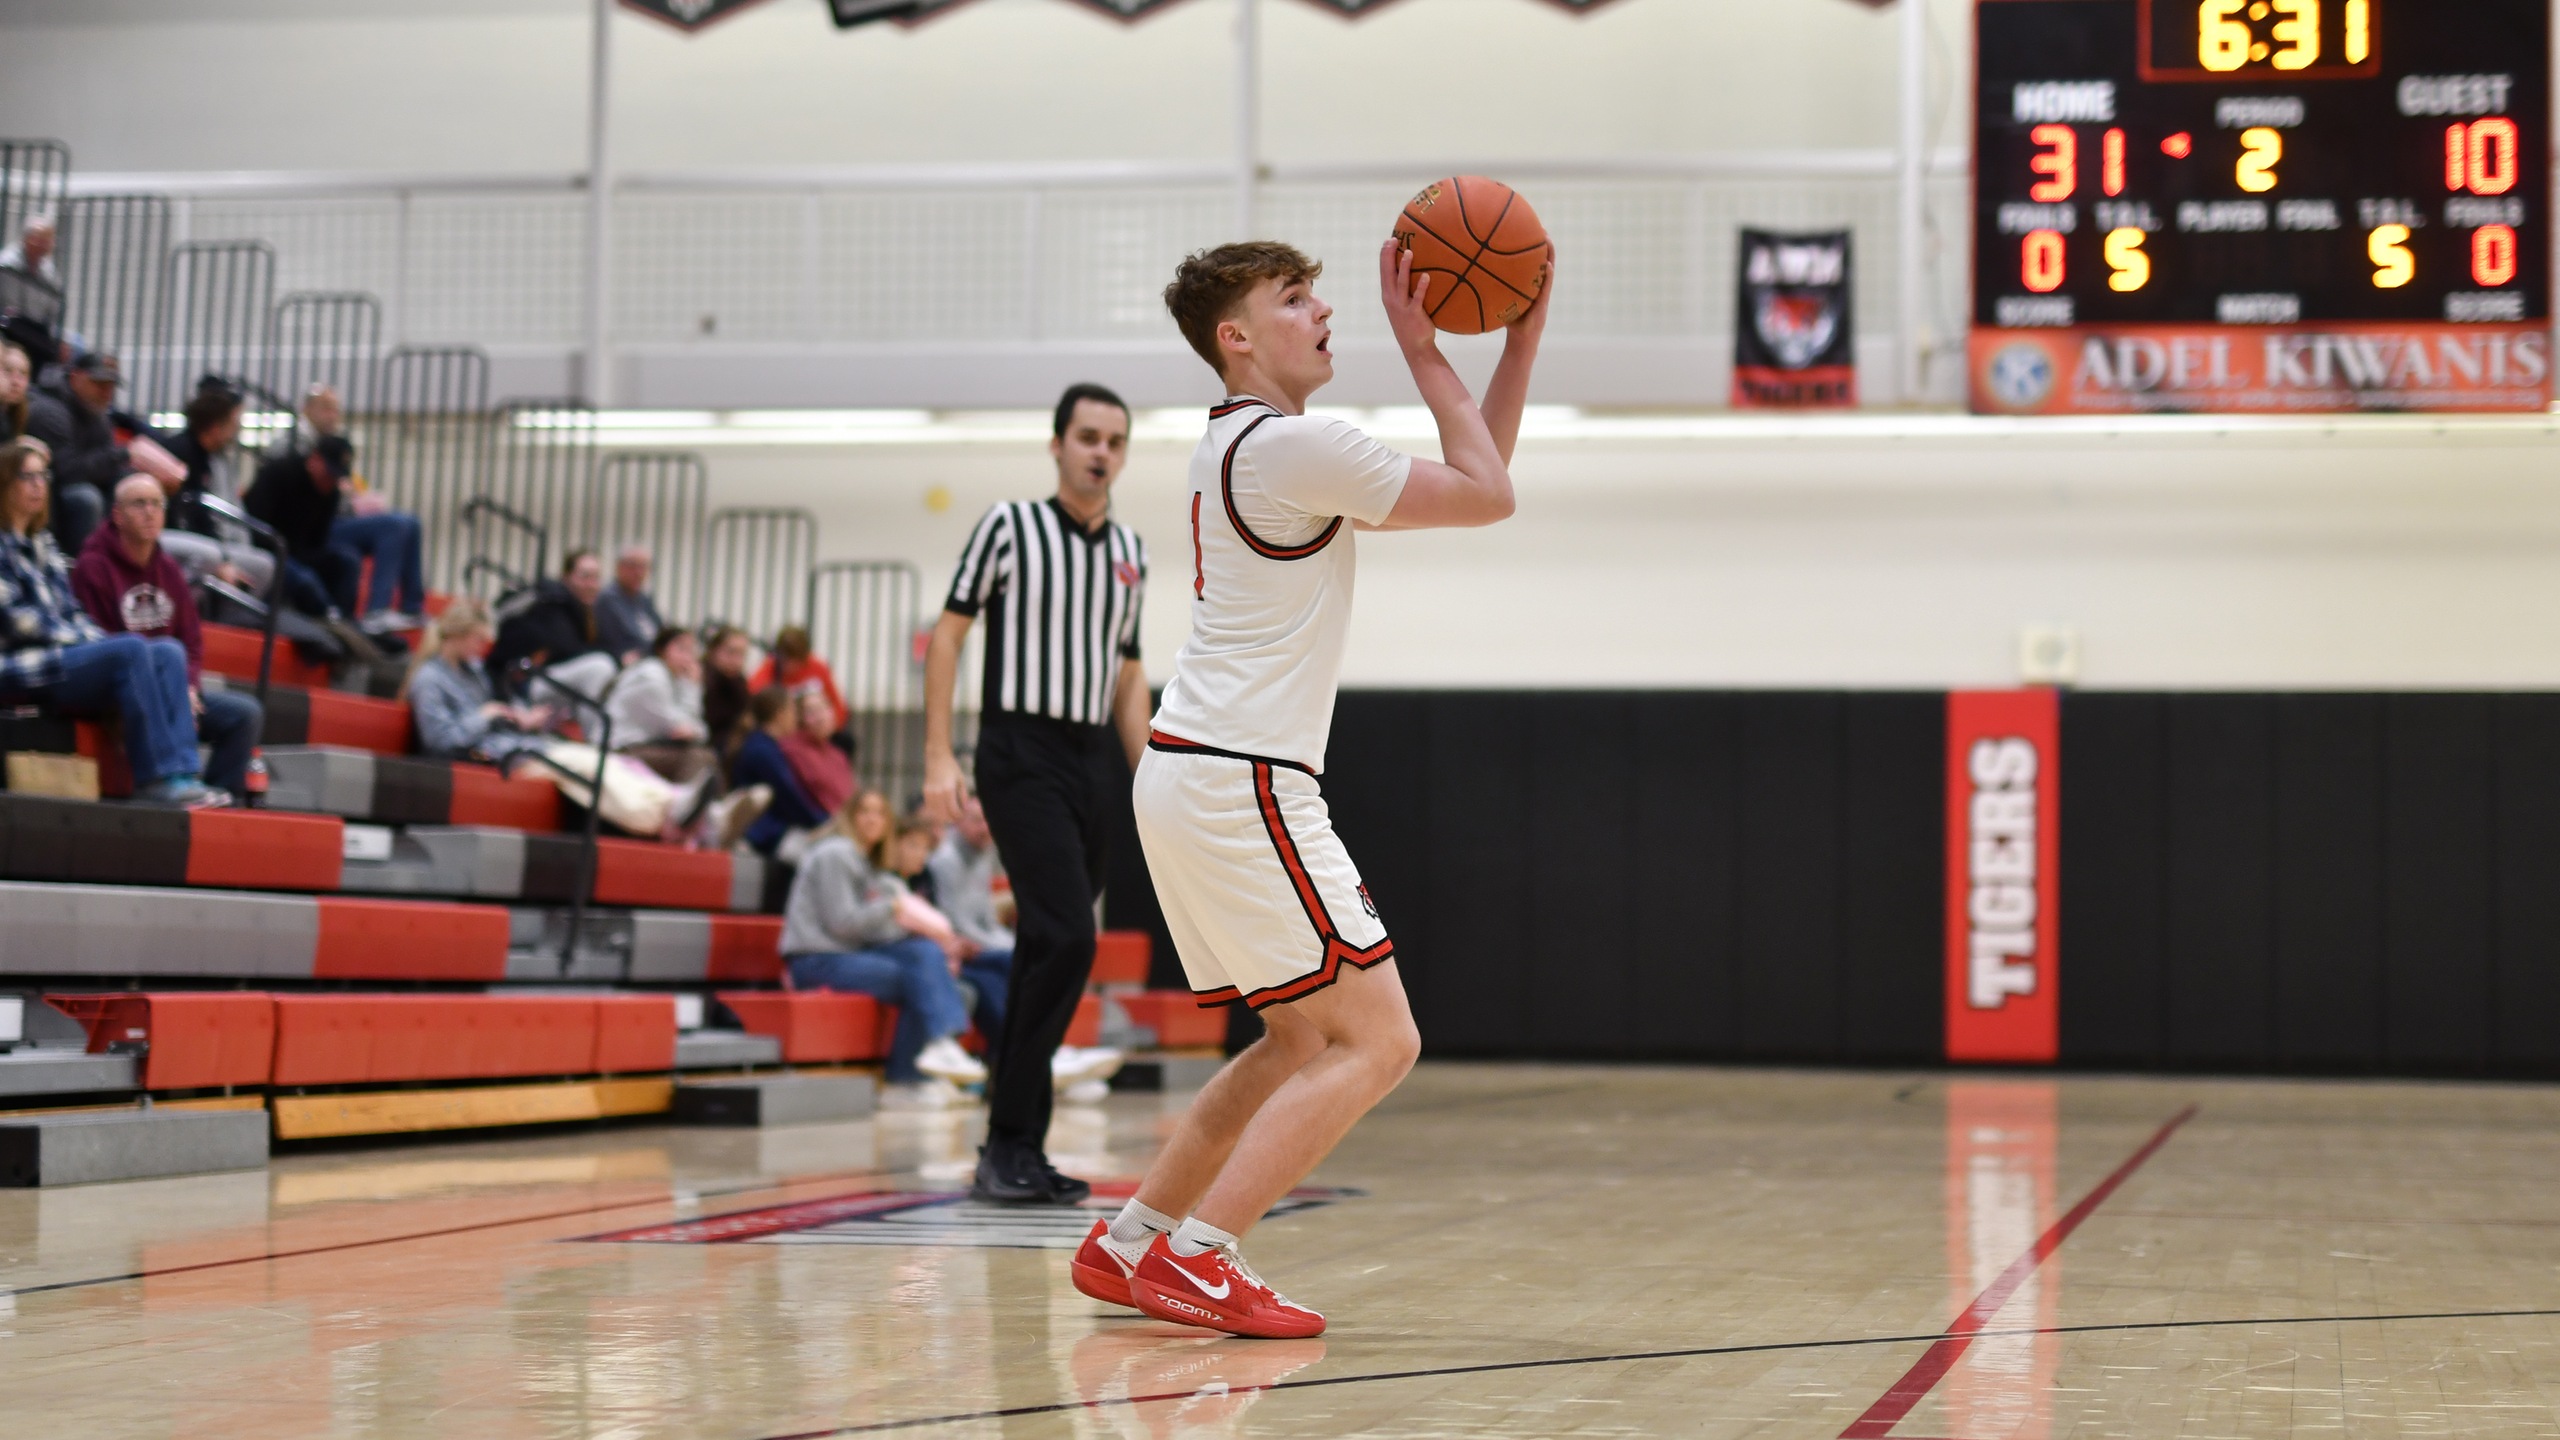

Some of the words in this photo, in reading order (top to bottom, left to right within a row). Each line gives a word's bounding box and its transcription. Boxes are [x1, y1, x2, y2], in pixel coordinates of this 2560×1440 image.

[2198, 0, 2369, 71] 6:31
[2013, 82, 2115, 122] HOME
[2215, 97, 2303, 127] PERIOD
[2399, 76, 2511, 115] GUEST
[2236, 127, 2282, 192] 2
[2445, 117, 2518, 195] 10
[2021, 228, 2066, 292] 0
[2104, 226, 2150, 292] 5
[2368, 223, 2415, 289] 5
[2471, 223, 2516, 286] 0
[2073, 335, 2248, 390] ADEL
[2264, 331, 2547, 388] KIWANIS
[1968, 736, 2038, 1009] TIGERS
